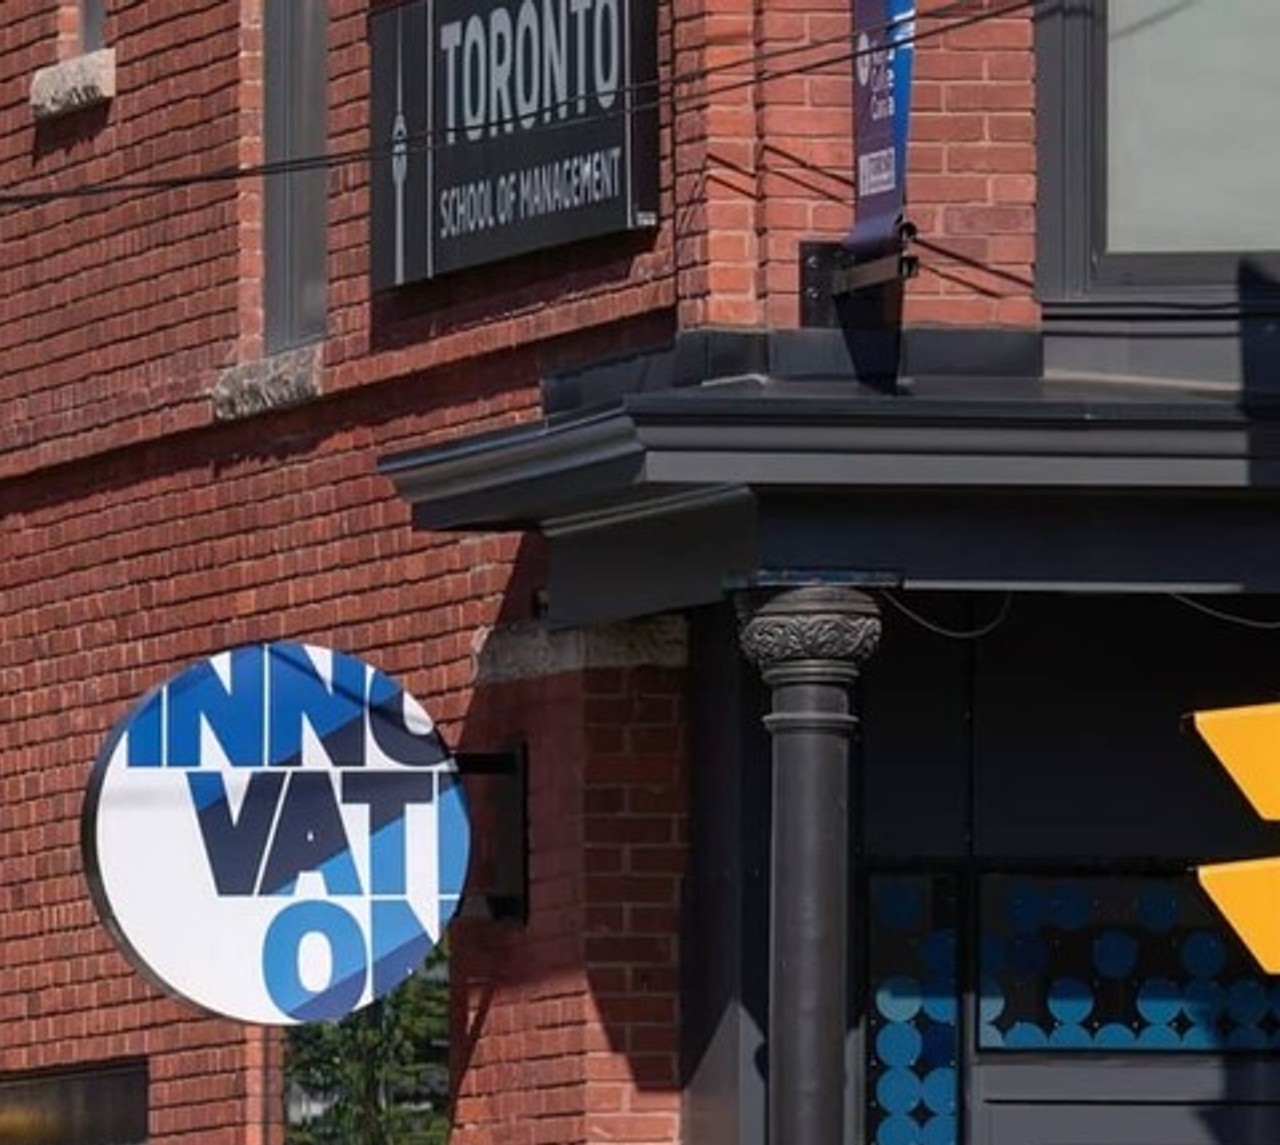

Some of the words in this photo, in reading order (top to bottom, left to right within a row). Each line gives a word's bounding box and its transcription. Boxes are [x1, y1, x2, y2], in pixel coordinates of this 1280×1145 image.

[440, 0, 619, 144] TORONTO
[440, 179, 495, 239] SCHOOL
[496, 172, 516, 226] OF
[521, 147, 620, 220] MANAGEMENT
